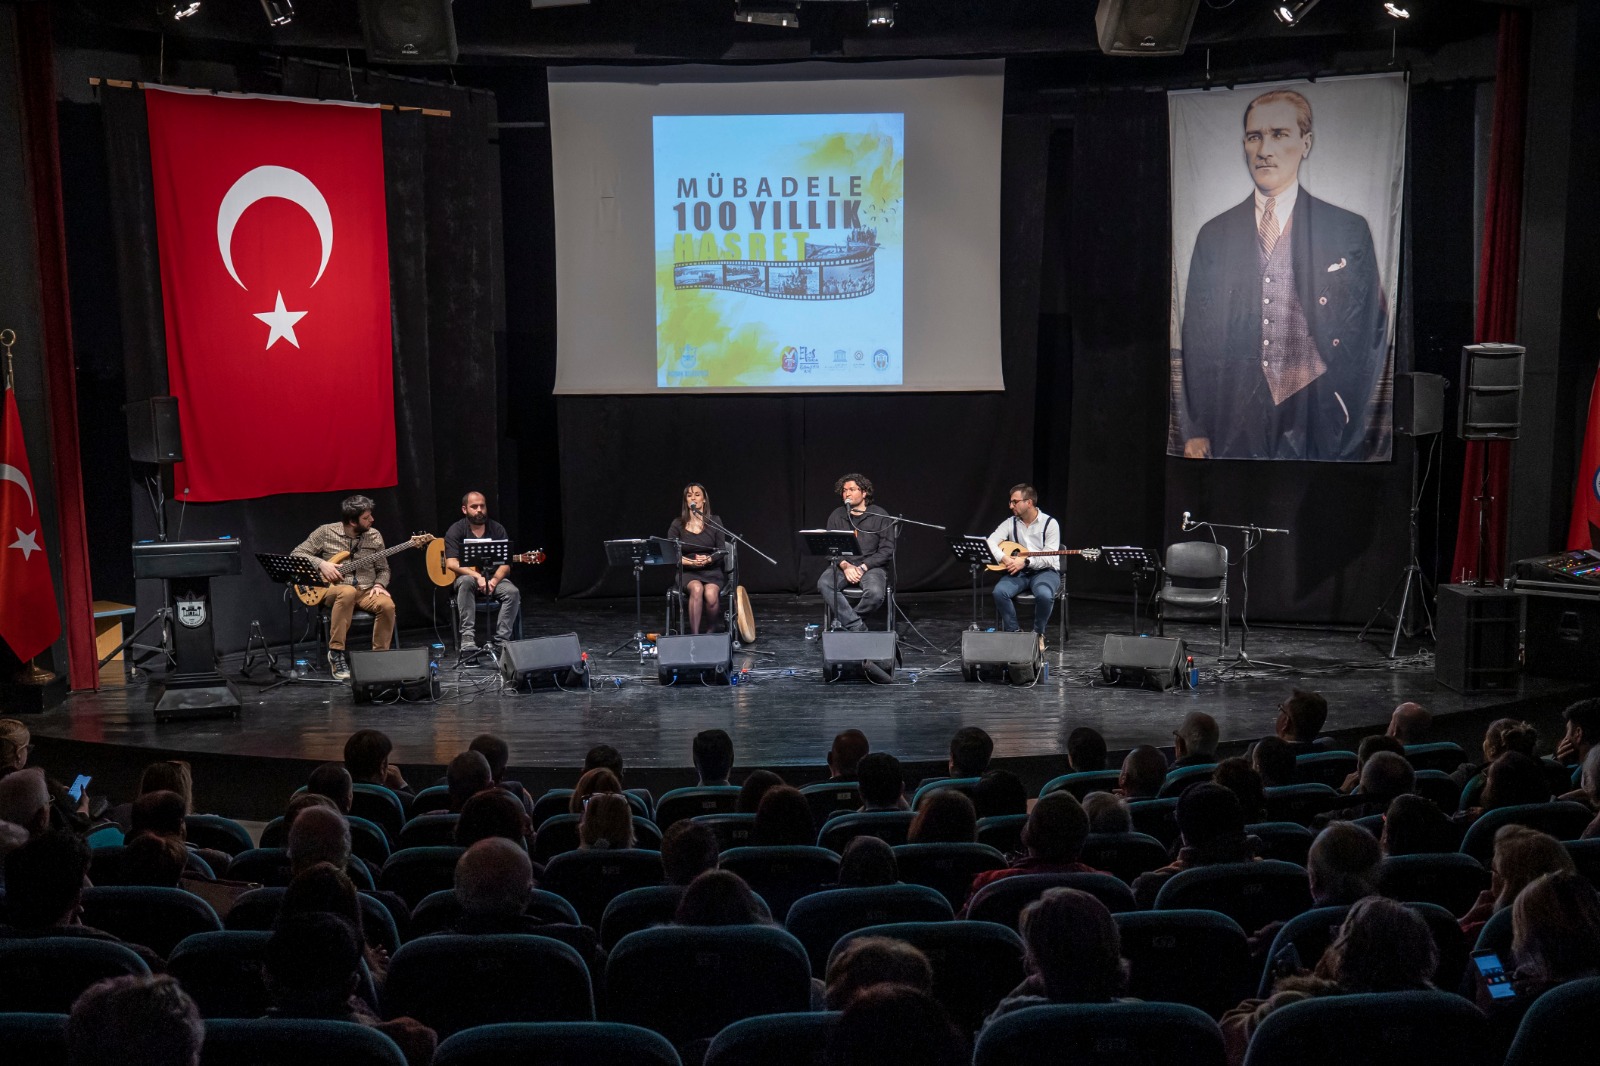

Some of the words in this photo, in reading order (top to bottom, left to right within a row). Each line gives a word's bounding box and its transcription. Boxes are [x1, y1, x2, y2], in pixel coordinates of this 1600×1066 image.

[677, 172, 862, 198] MÜBADELE
[673, 201, 737, 231] 100
[749, 200, 862, 230] YILLIK
[673, 232, 810, 262] HASRET
